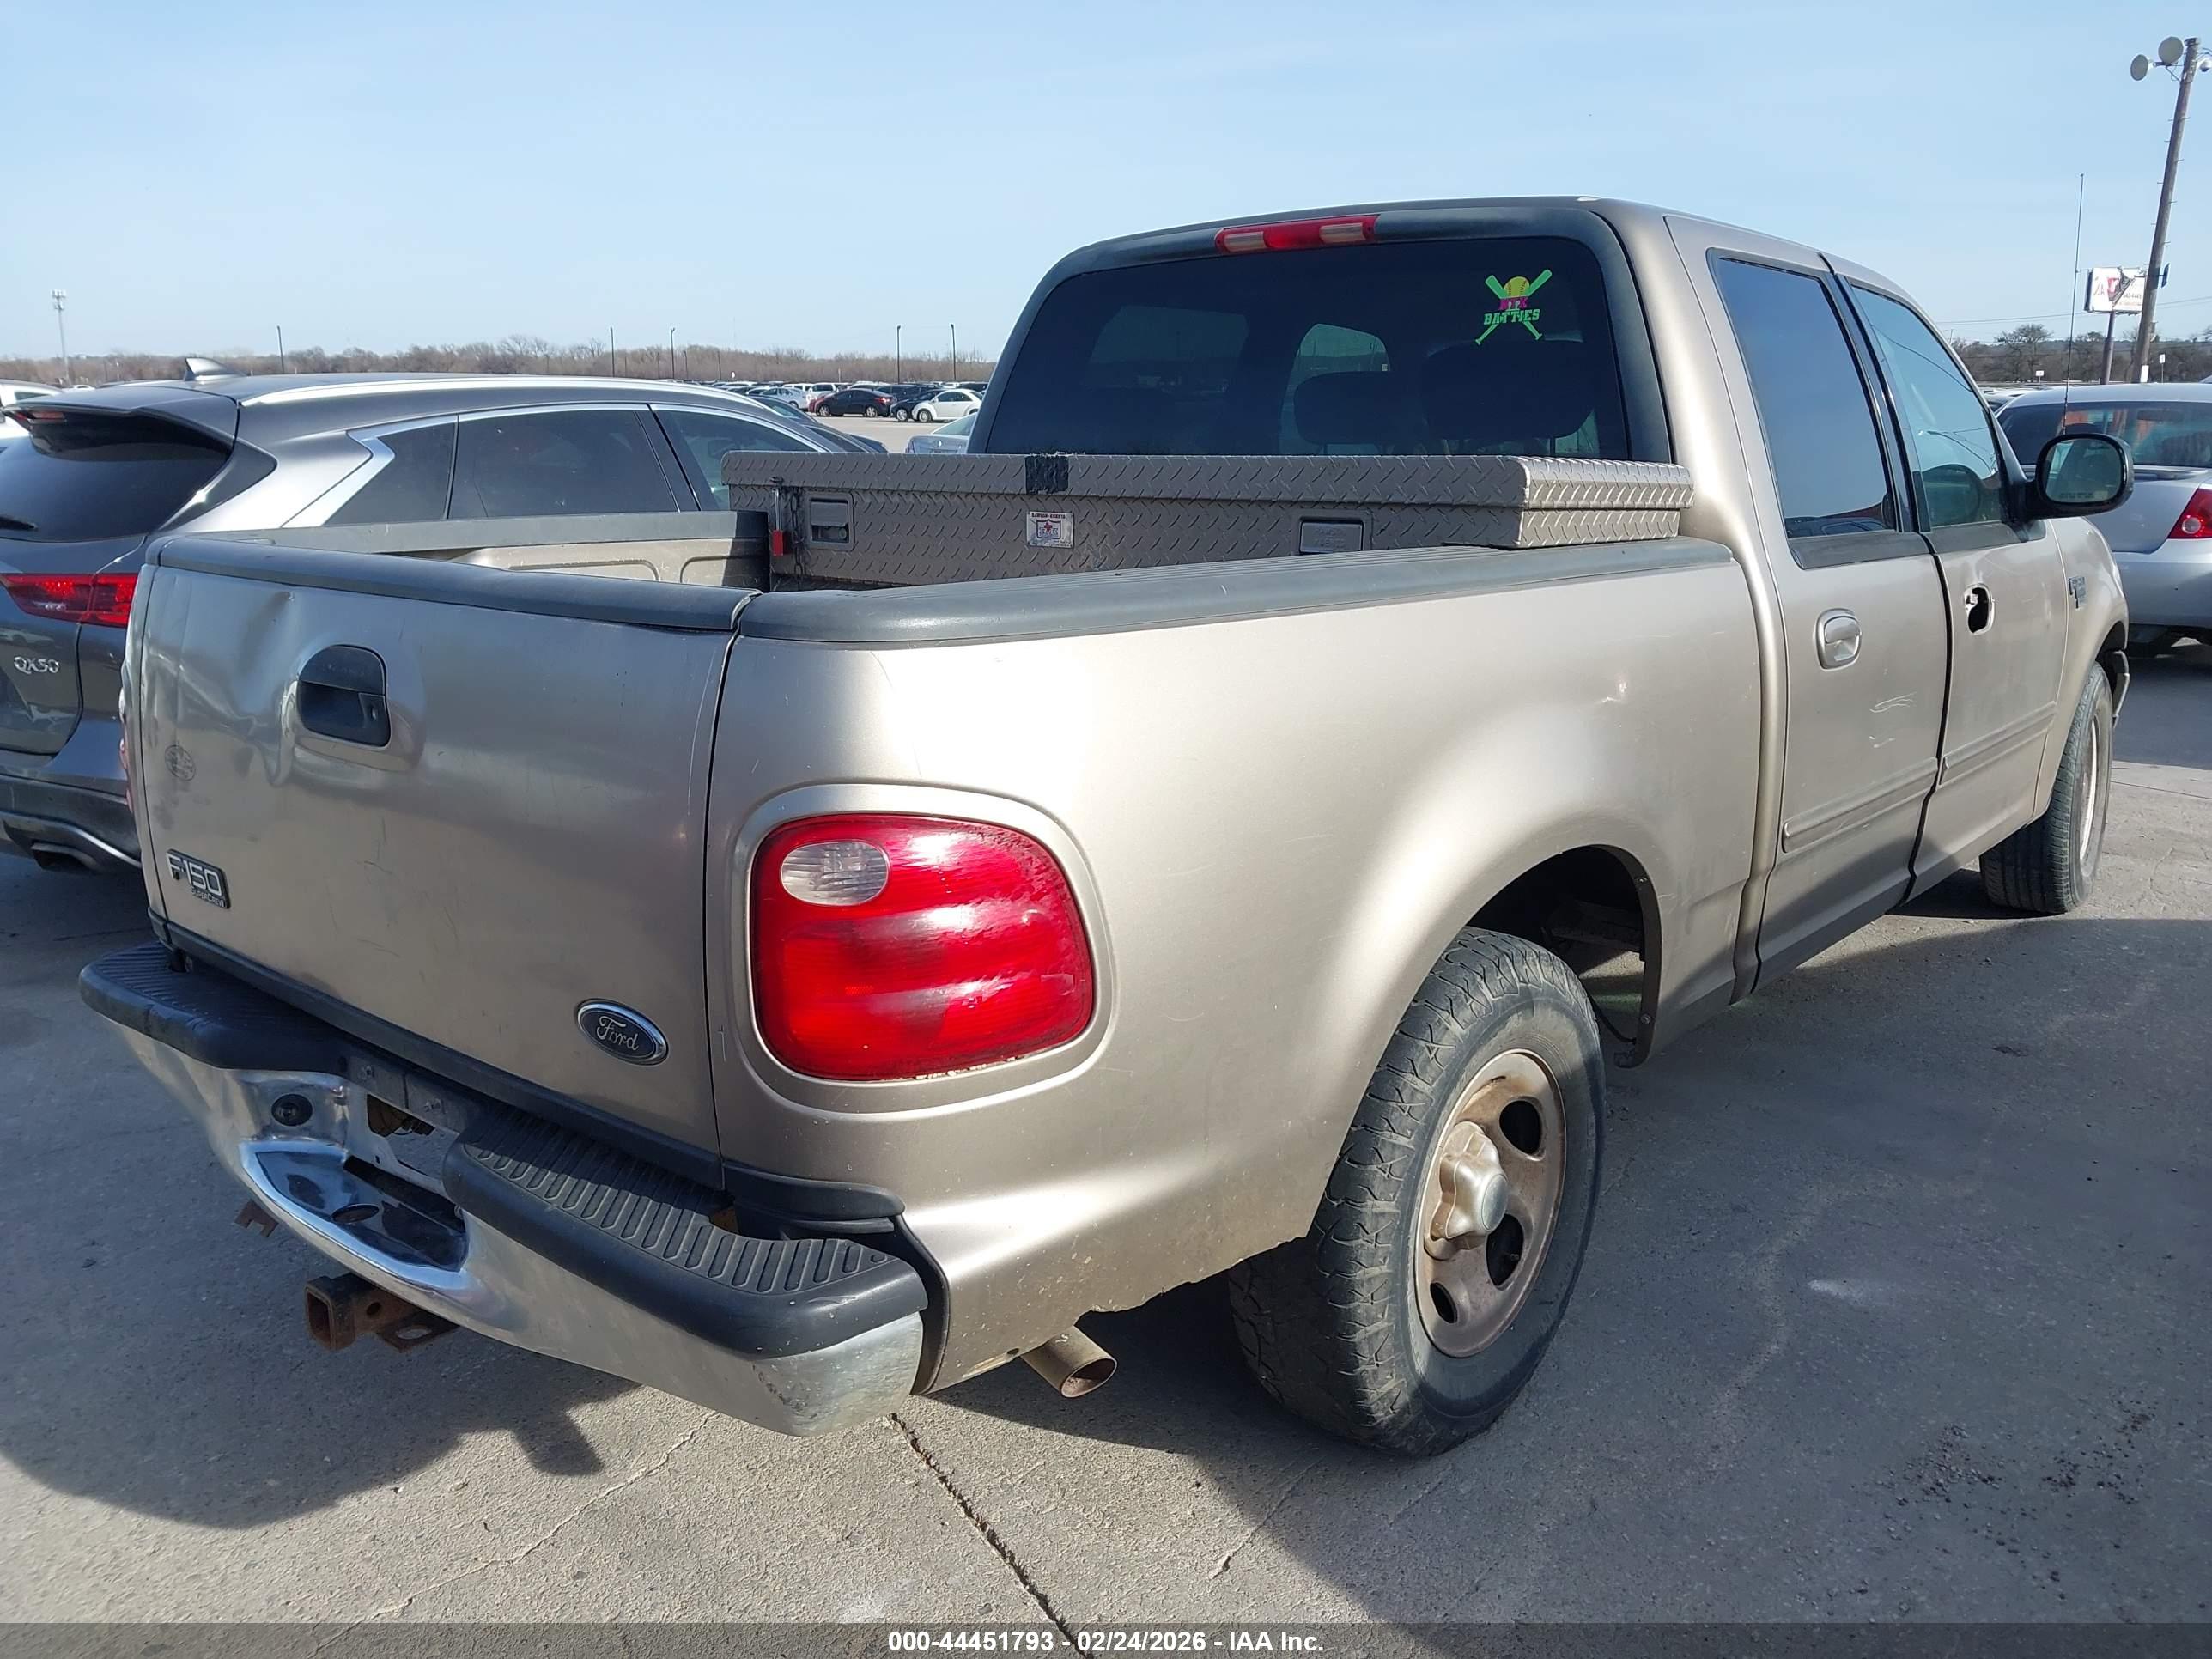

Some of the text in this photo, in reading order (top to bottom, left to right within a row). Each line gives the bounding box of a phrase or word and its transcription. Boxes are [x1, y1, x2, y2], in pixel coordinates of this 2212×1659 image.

[1484, 309, 1540, 325] BATTIES
[14, 656, 59, 674] QX50
[596, 1015, 640, 1051] Ford
